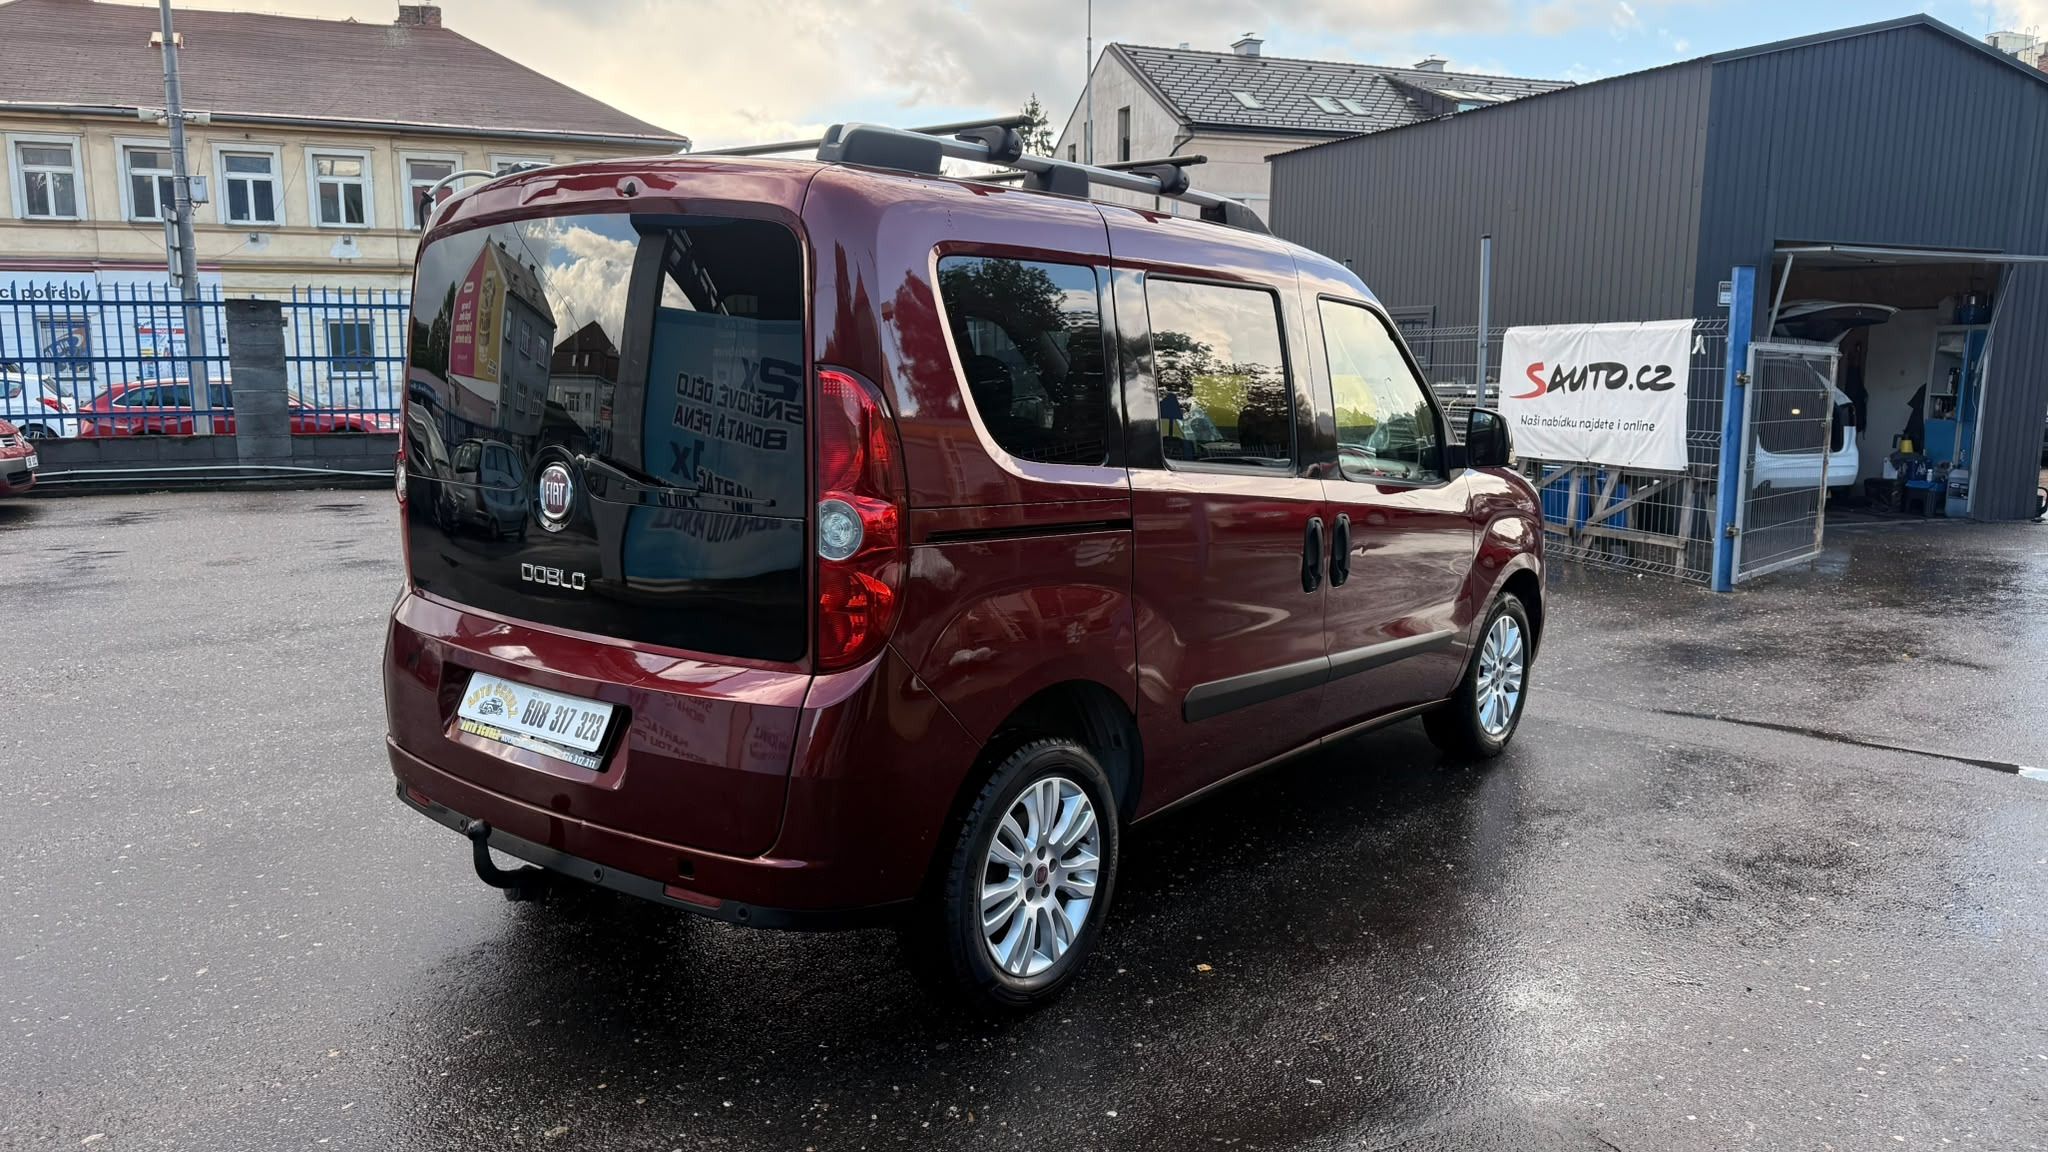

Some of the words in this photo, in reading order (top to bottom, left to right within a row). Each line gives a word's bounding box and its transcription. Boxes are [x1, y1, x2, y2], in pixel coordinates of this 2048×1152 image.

[1509, 361, 1676, 399] SAUTO.CZ
[1520, 414, 1540, 426] Naši
[1541, 415, 1577, 428] nabídku
[1579, 418, 1614, 434] najdete
[1617, 419, 1621, 430] i
[1623, 418, 1655, 432] online
[546, 481, 565, 505] FIAT
[521, 562, 586, 591] DOBLO
[520, 699, 551, 729] 608
[550, 705, 578, 735] 317
[574, 711, 605, 743] 323
